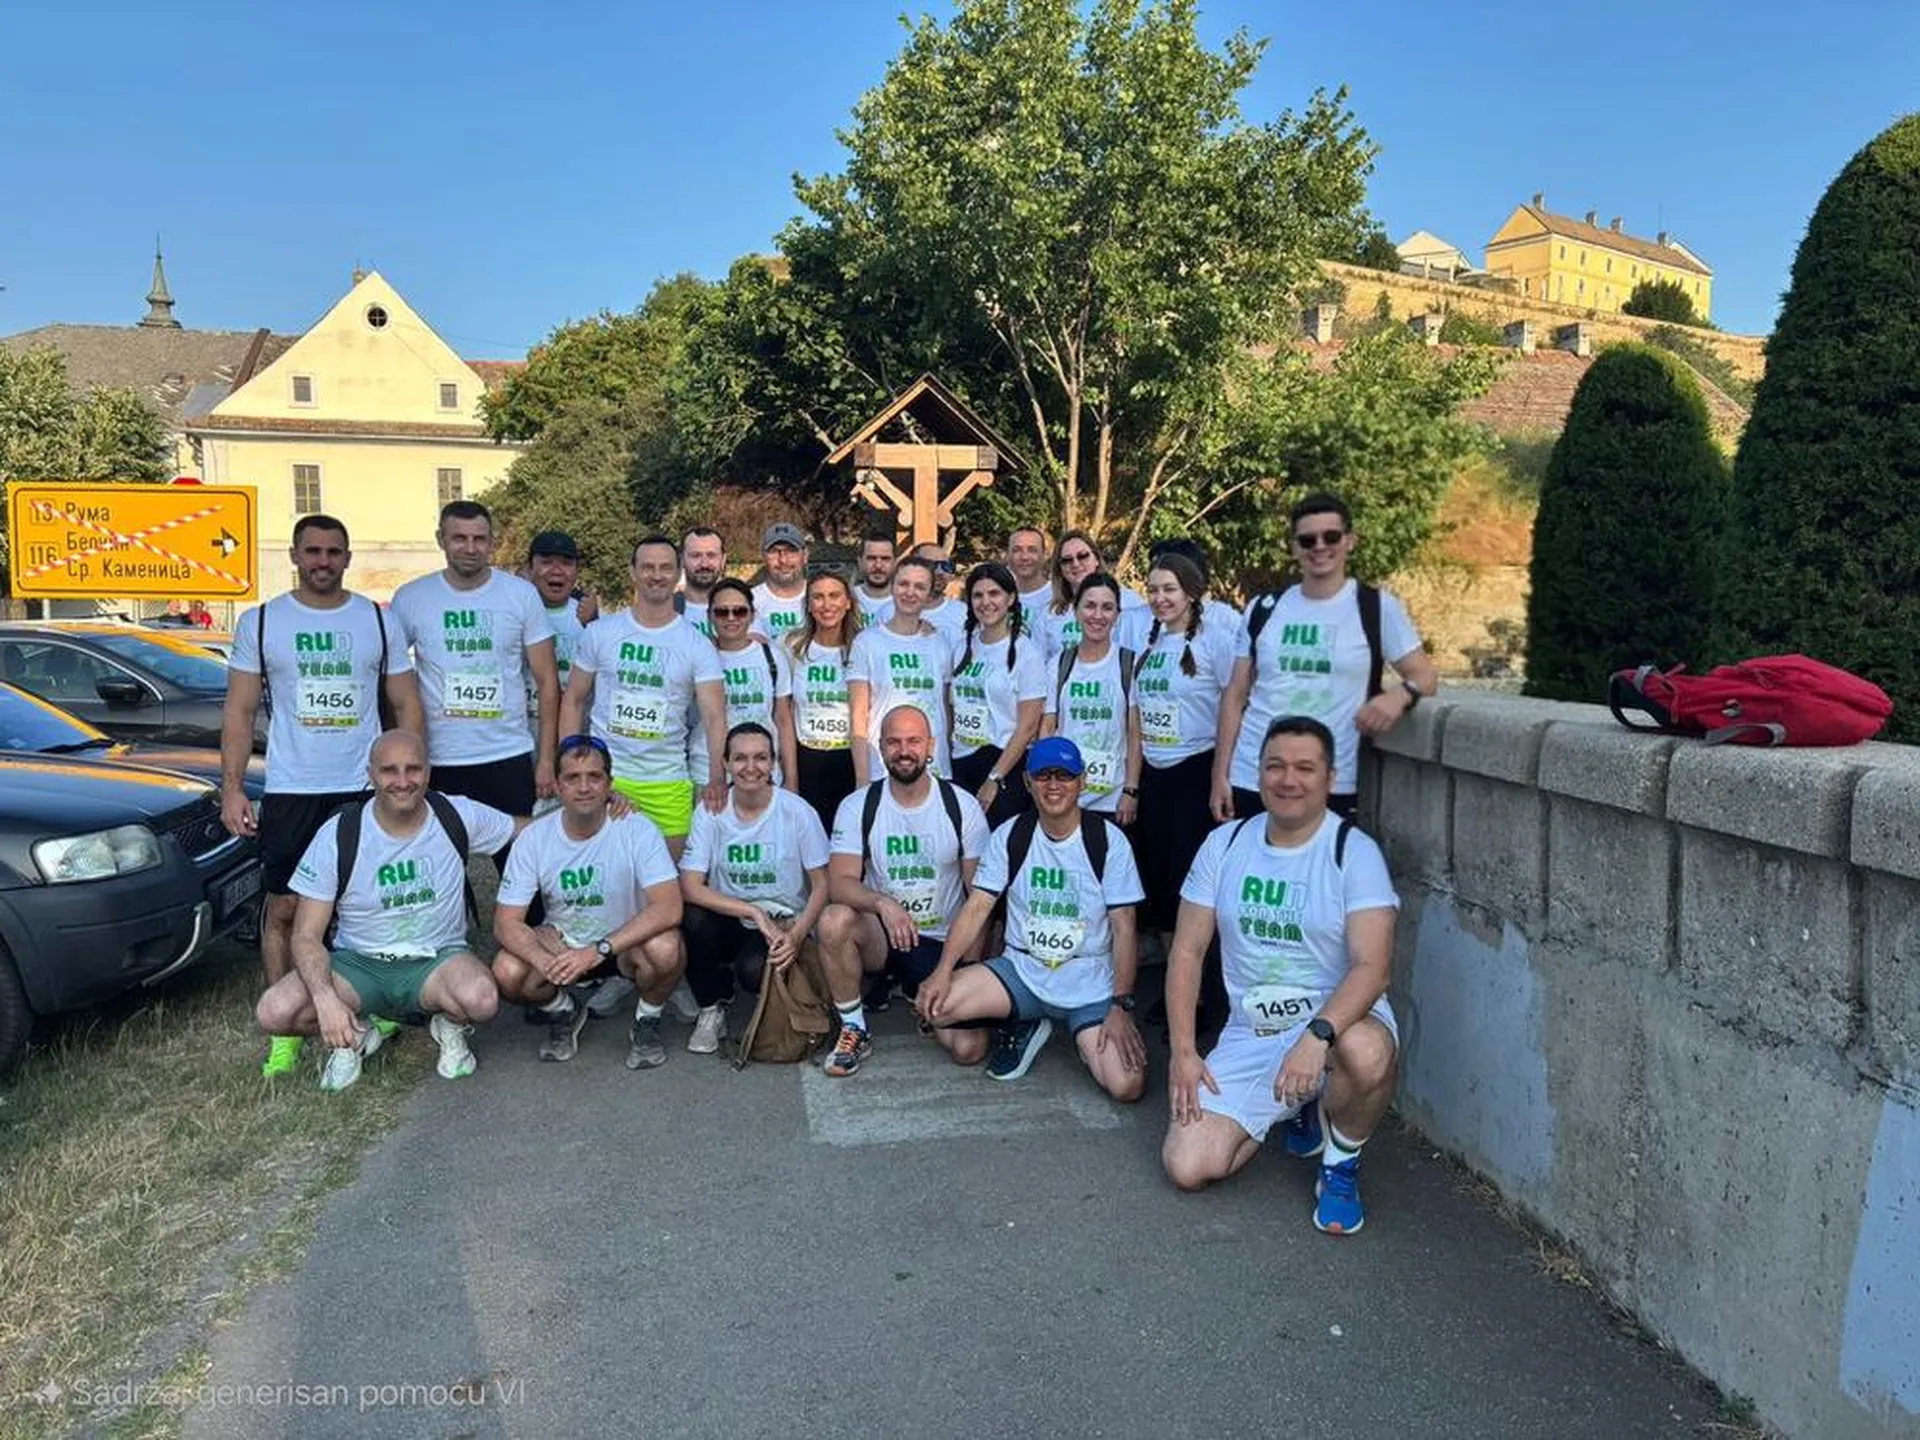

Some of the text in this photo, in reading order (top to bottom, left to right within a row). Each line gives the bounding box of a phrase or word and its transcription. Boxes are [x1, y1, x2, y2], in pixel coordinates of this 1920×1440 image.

[103, 557, 191, 580] Каменица
[306, 693, 354, 708] 1456
[453, 686, 497, 701] 1457
[616, 704, 658, 723] 1454
[807, 718, 848, 733] 1458
[1028, 930, 1075, 950] 1466
[1256, 998, 1314, 1019] 1451
